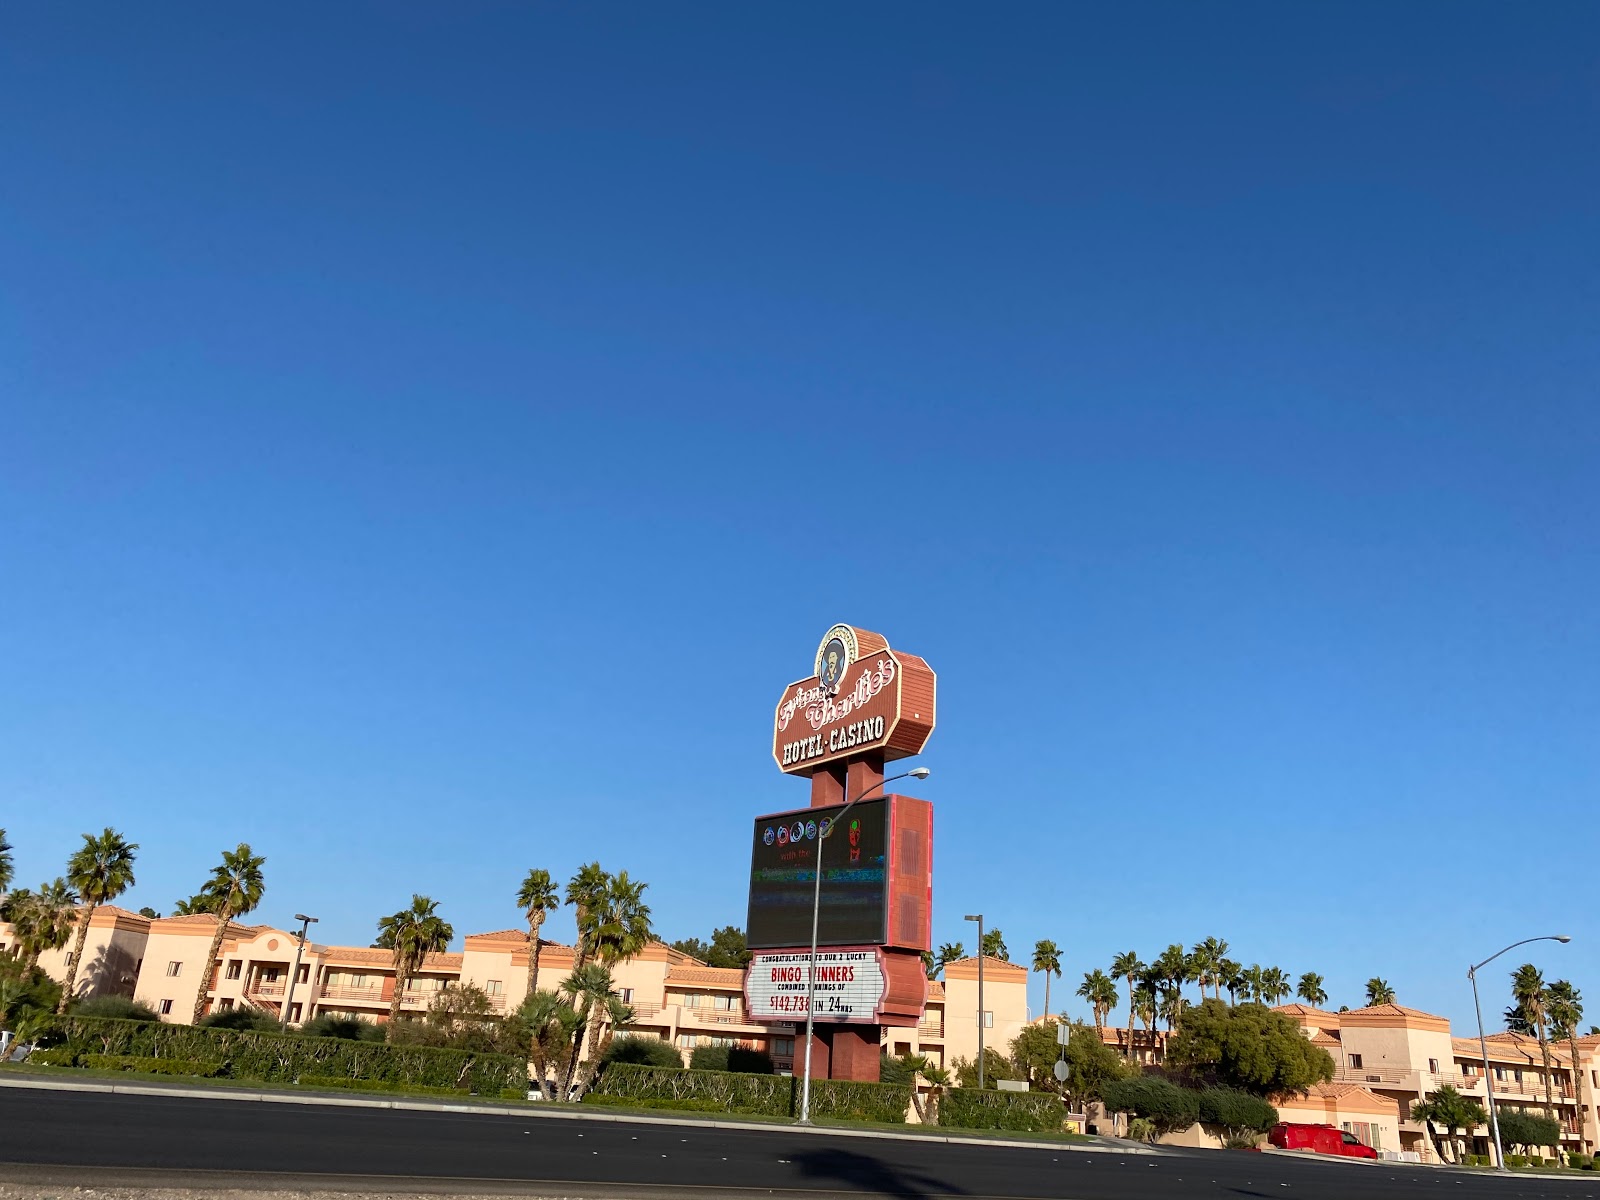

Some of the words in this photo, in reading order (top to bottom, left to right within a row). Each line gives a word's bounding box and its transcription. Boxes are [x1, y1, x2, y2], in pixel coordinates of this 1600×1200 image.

[782, 733, 825, 765] HOTEL
[830, 716, 885, 753] CASINO
[846, 953, 866, 961] LUCKY
[772, 967, 802, 982] BINGO
[816, 1000, 823, 1011] IN
